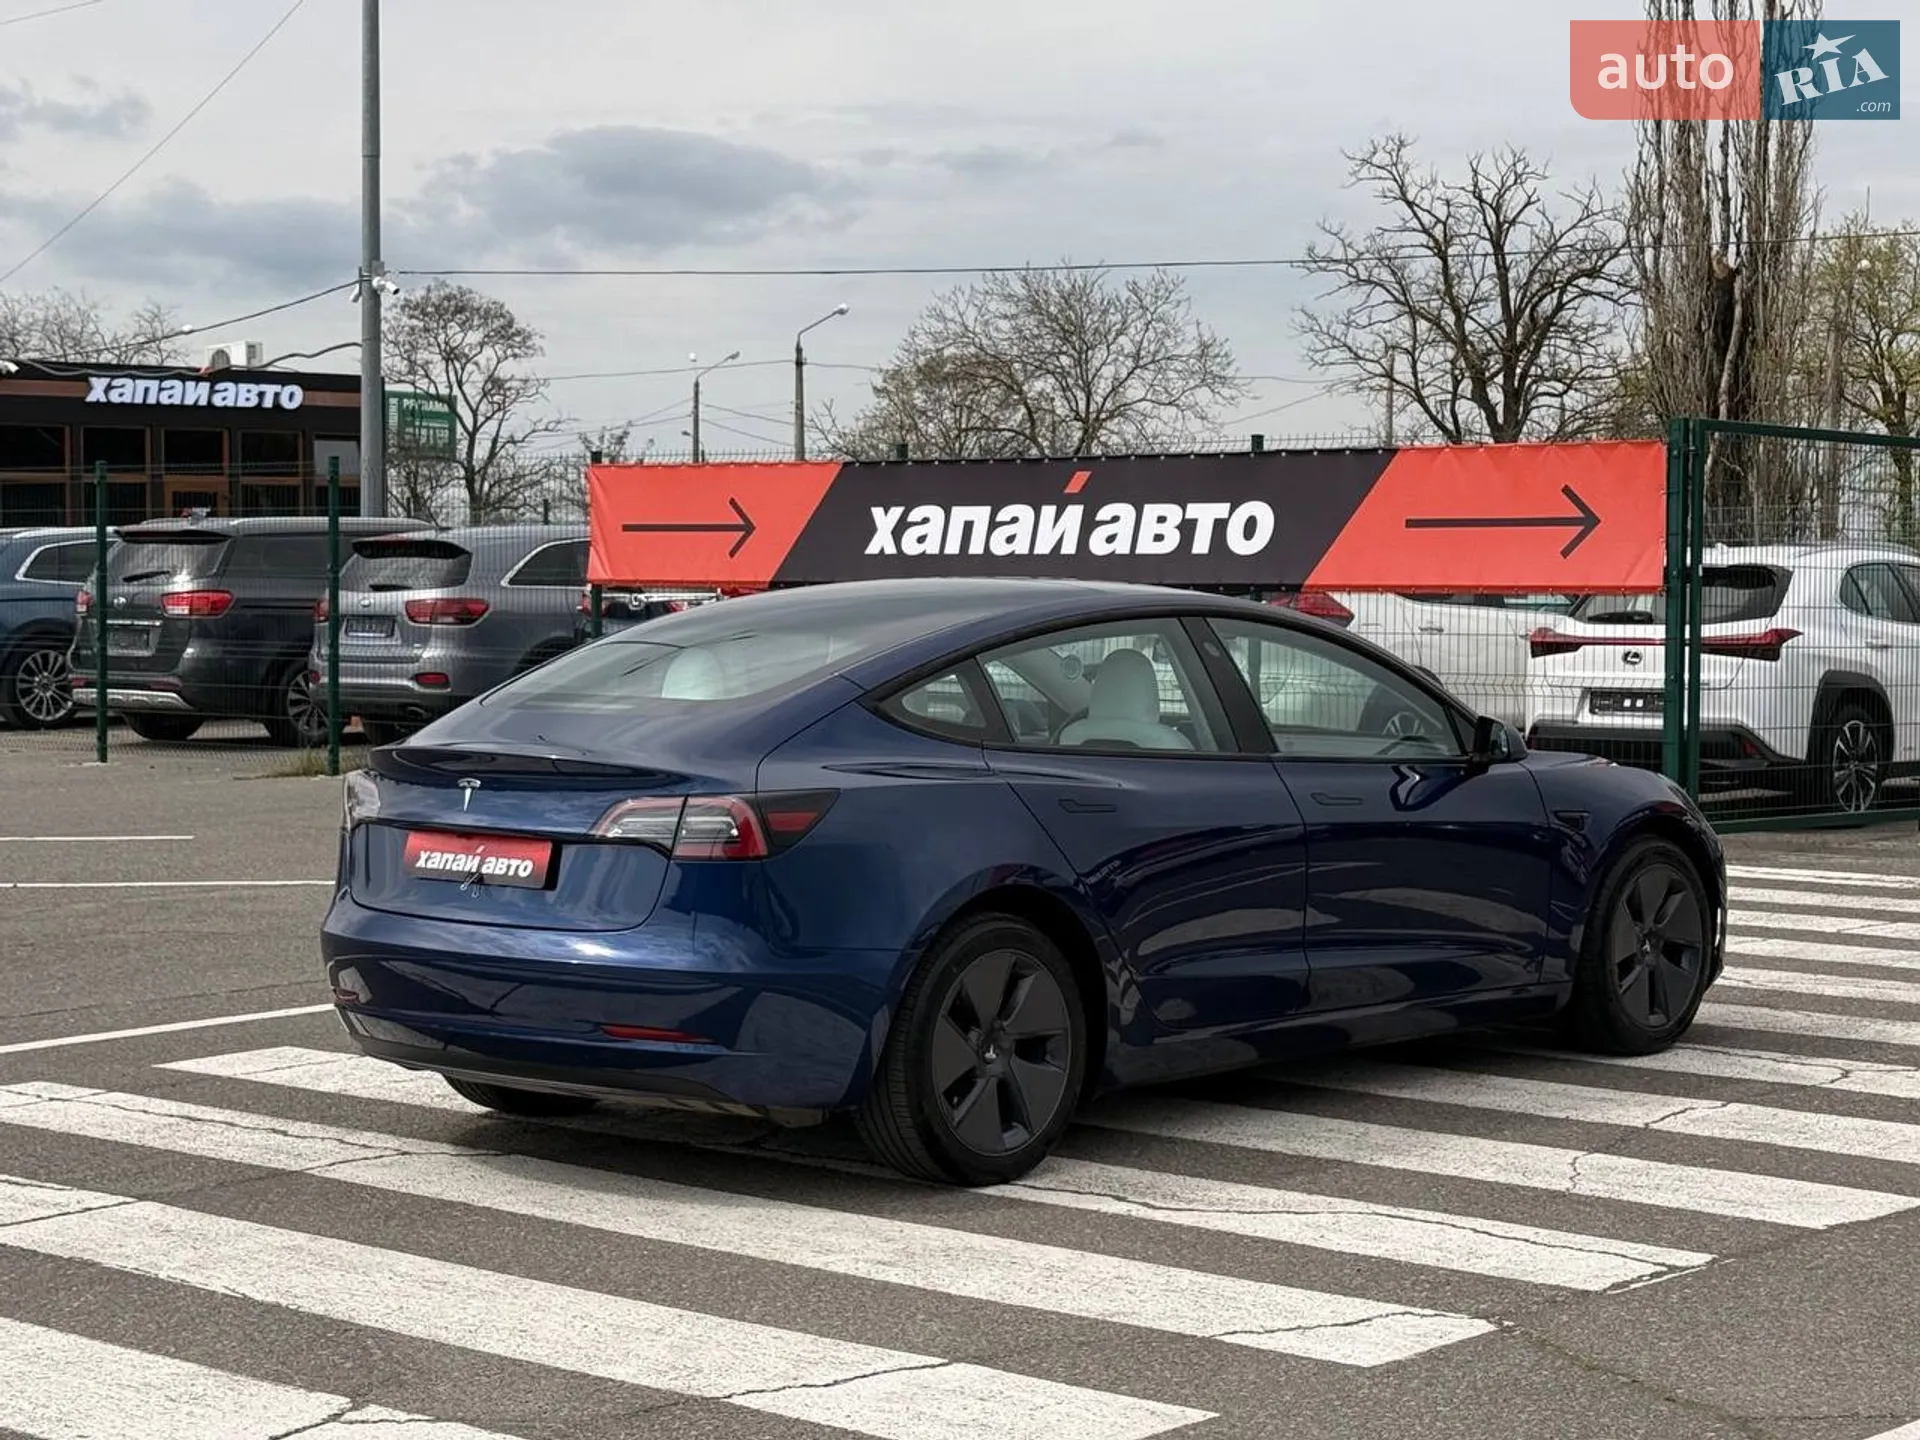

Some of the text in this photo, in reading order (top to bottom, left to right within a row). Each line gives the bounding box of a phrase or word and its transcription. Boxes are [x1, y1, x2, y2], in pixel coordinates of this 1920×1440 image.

[211, 381, 304, 410] авто
[864, 471, 1275, 556] хапай авто
[415, 845, 534, 878] хапай авто
